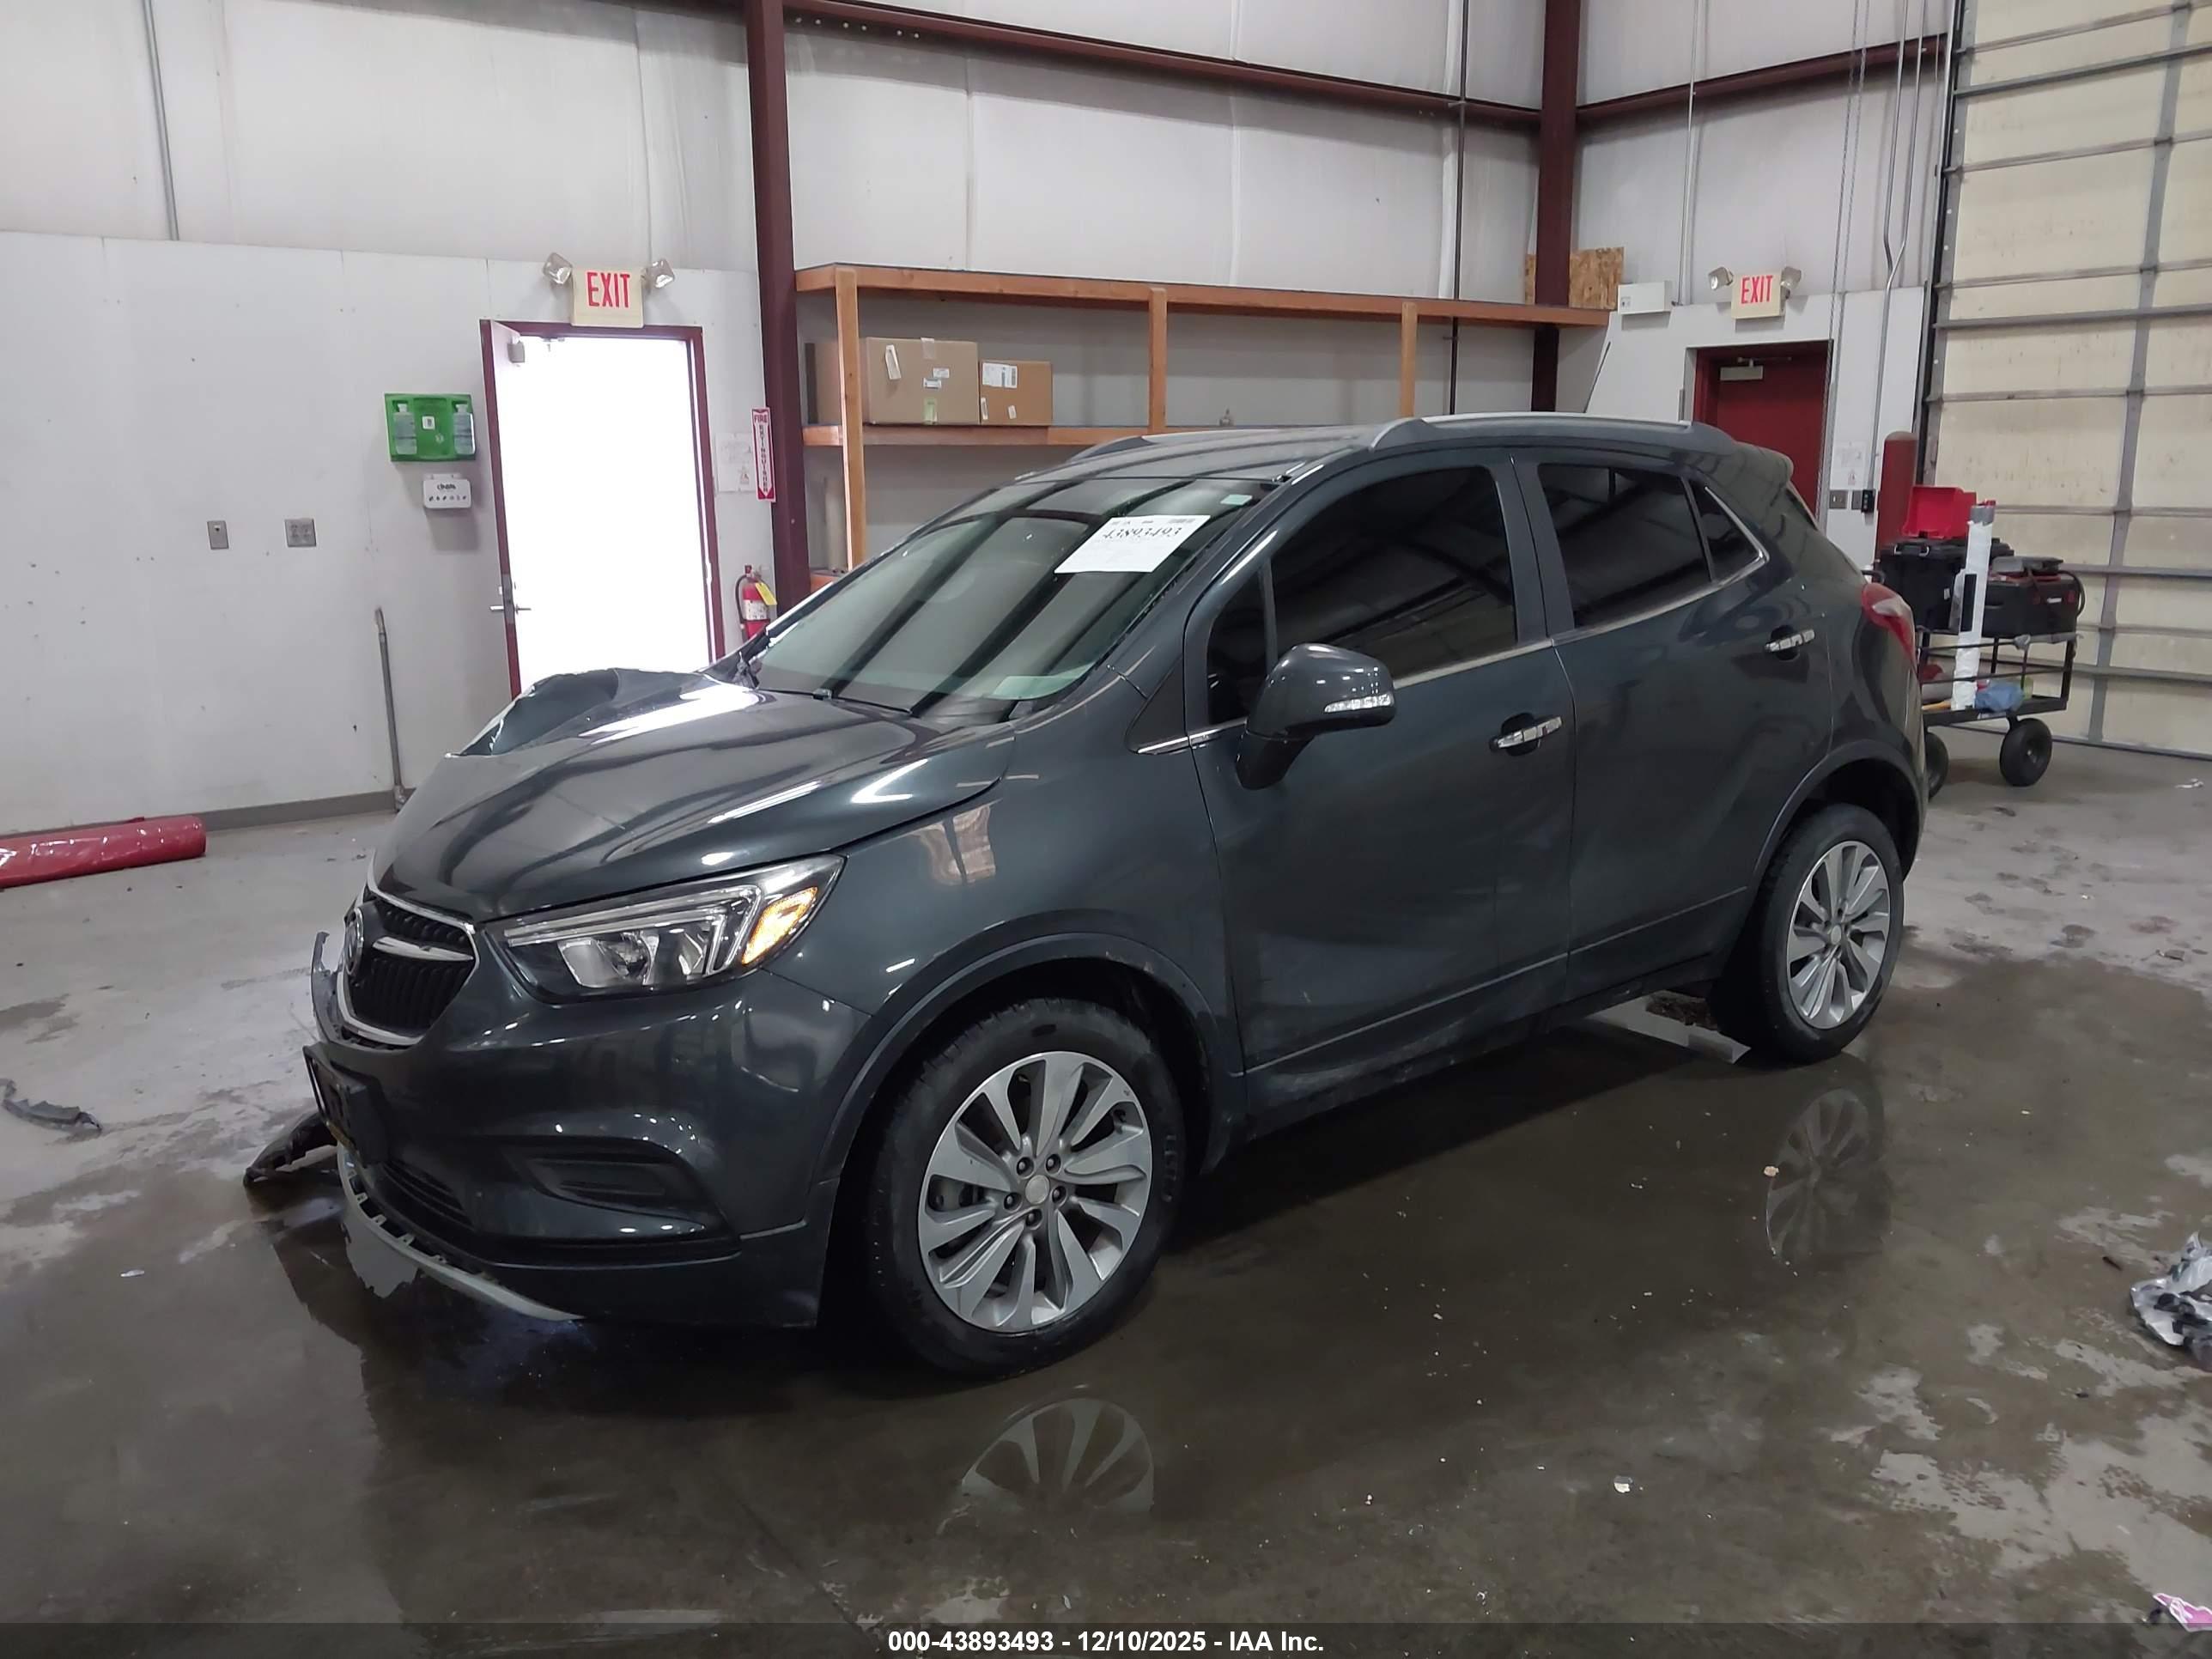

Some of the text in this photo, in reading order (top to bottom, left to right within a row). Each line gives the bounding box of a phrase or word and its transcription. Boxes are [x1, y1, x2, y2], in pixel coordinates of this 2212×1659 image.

[586, 271, 631, 308] EXIT
[1741, 275, 1773, 304] EXIT
[754, 414, 768, 423] FIRE
